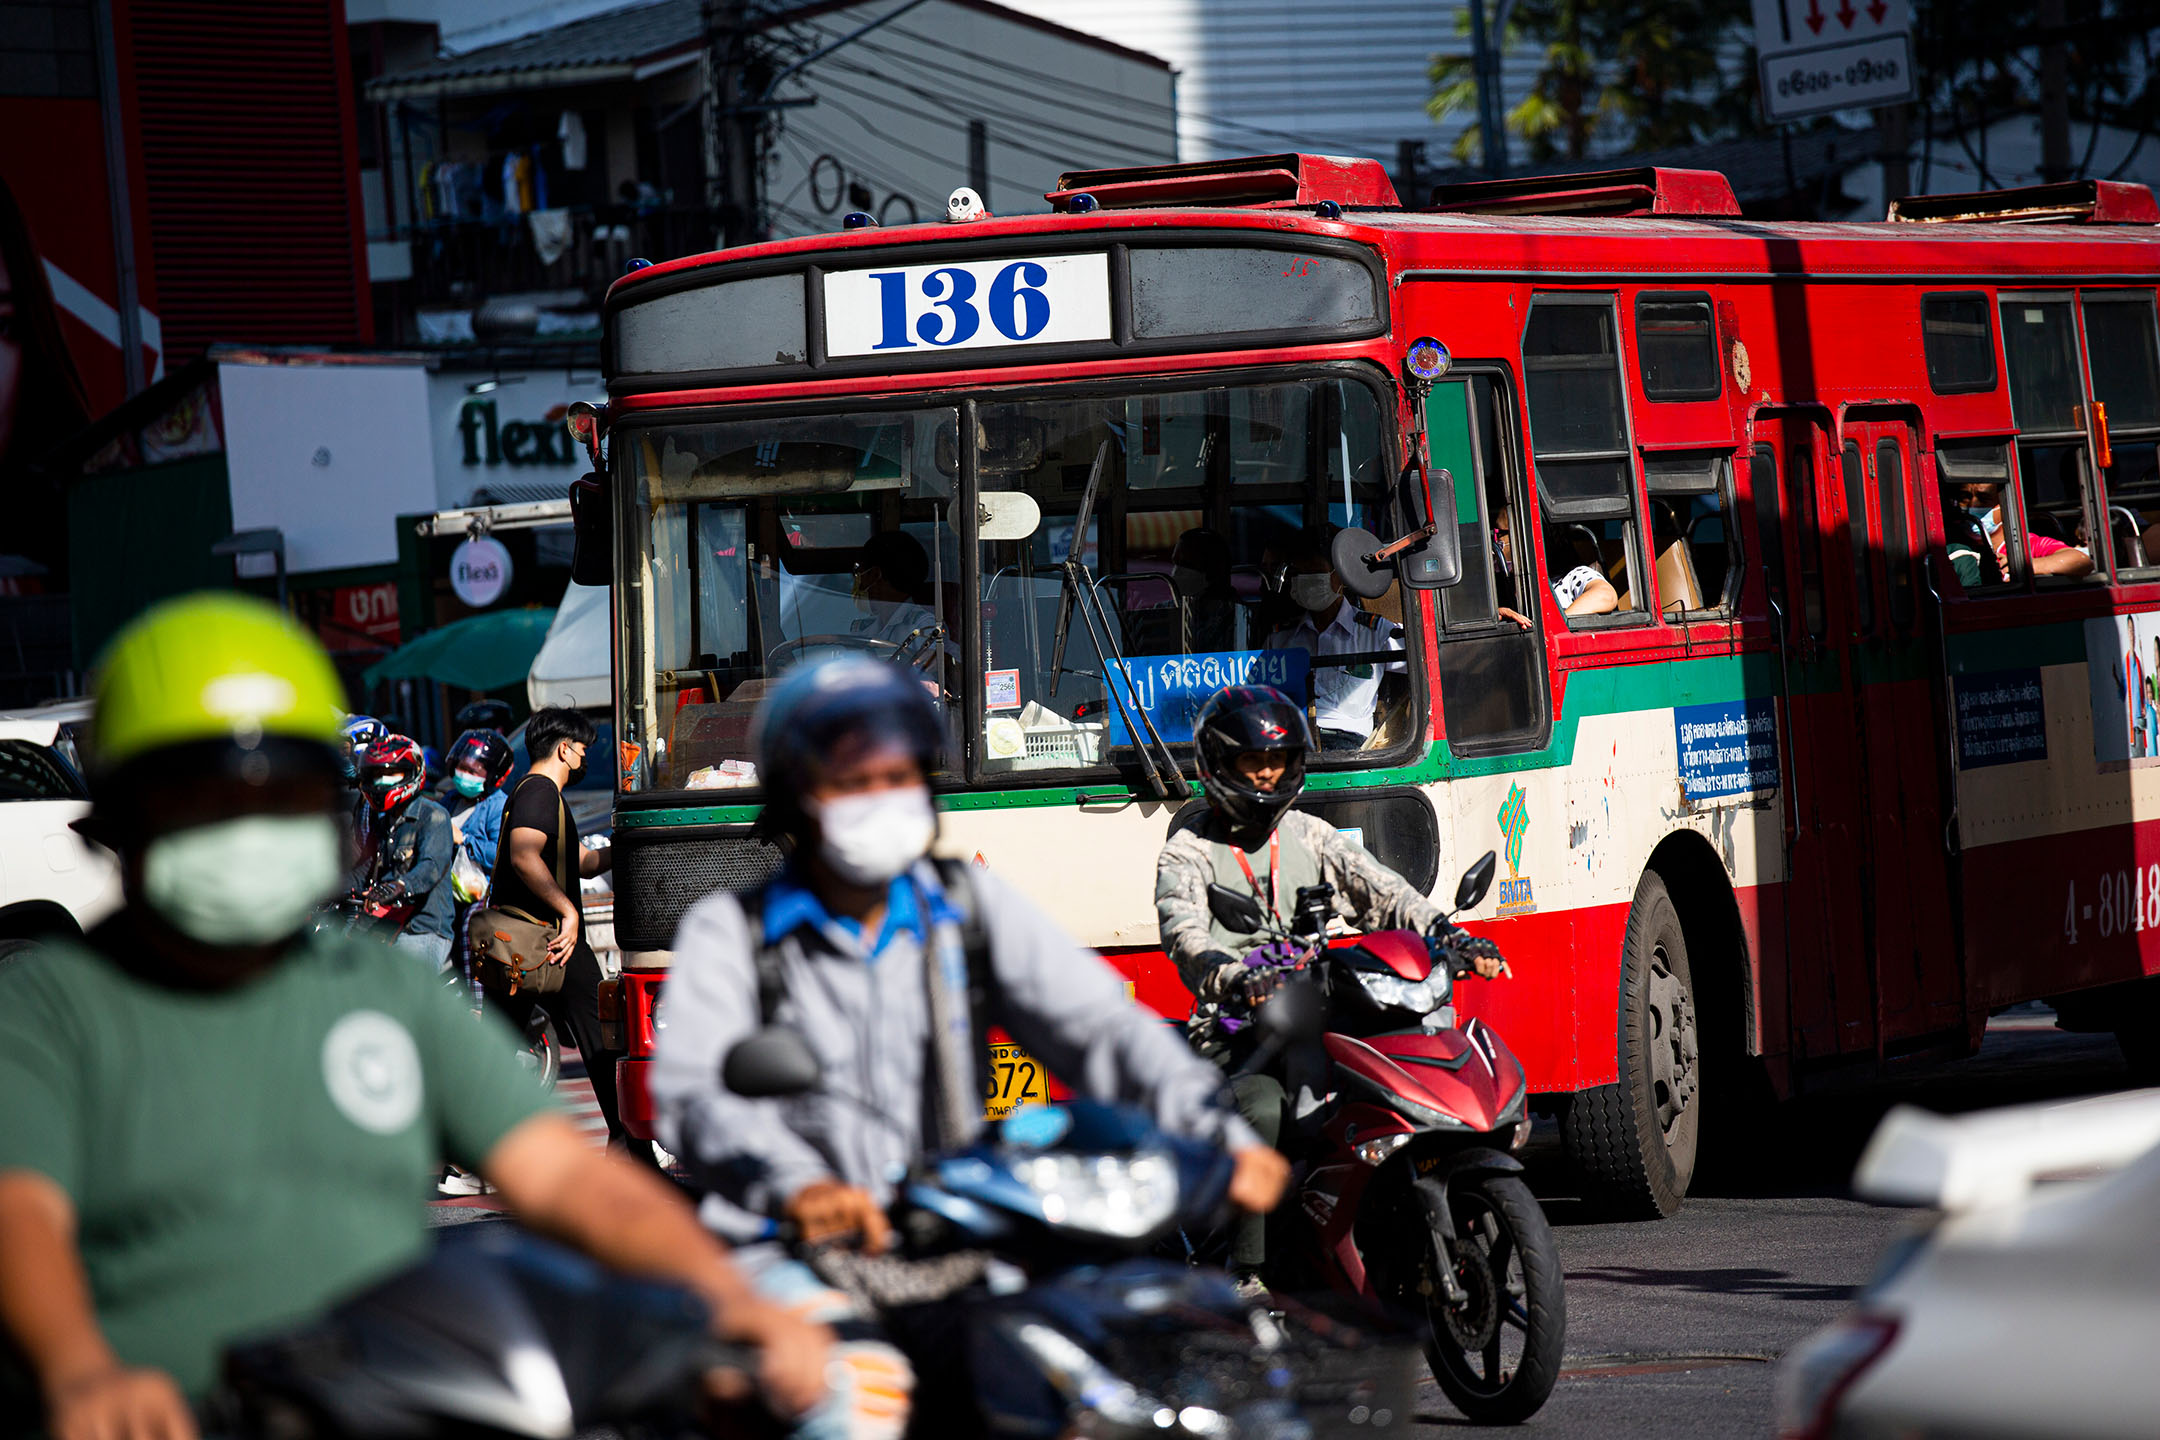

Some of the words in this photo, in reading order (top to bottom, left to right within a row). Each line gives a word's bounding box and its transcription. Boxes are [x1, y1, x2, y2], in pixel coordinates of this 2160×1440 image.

[868, 261, 1051, 350] 136
[460, 399, 577, 466] flexi
[1113, 659, 1156, 712] ไป
[1159, 654, 1289, 691] คลองเตย
[1499, 879, 1534, 905] BMTA
